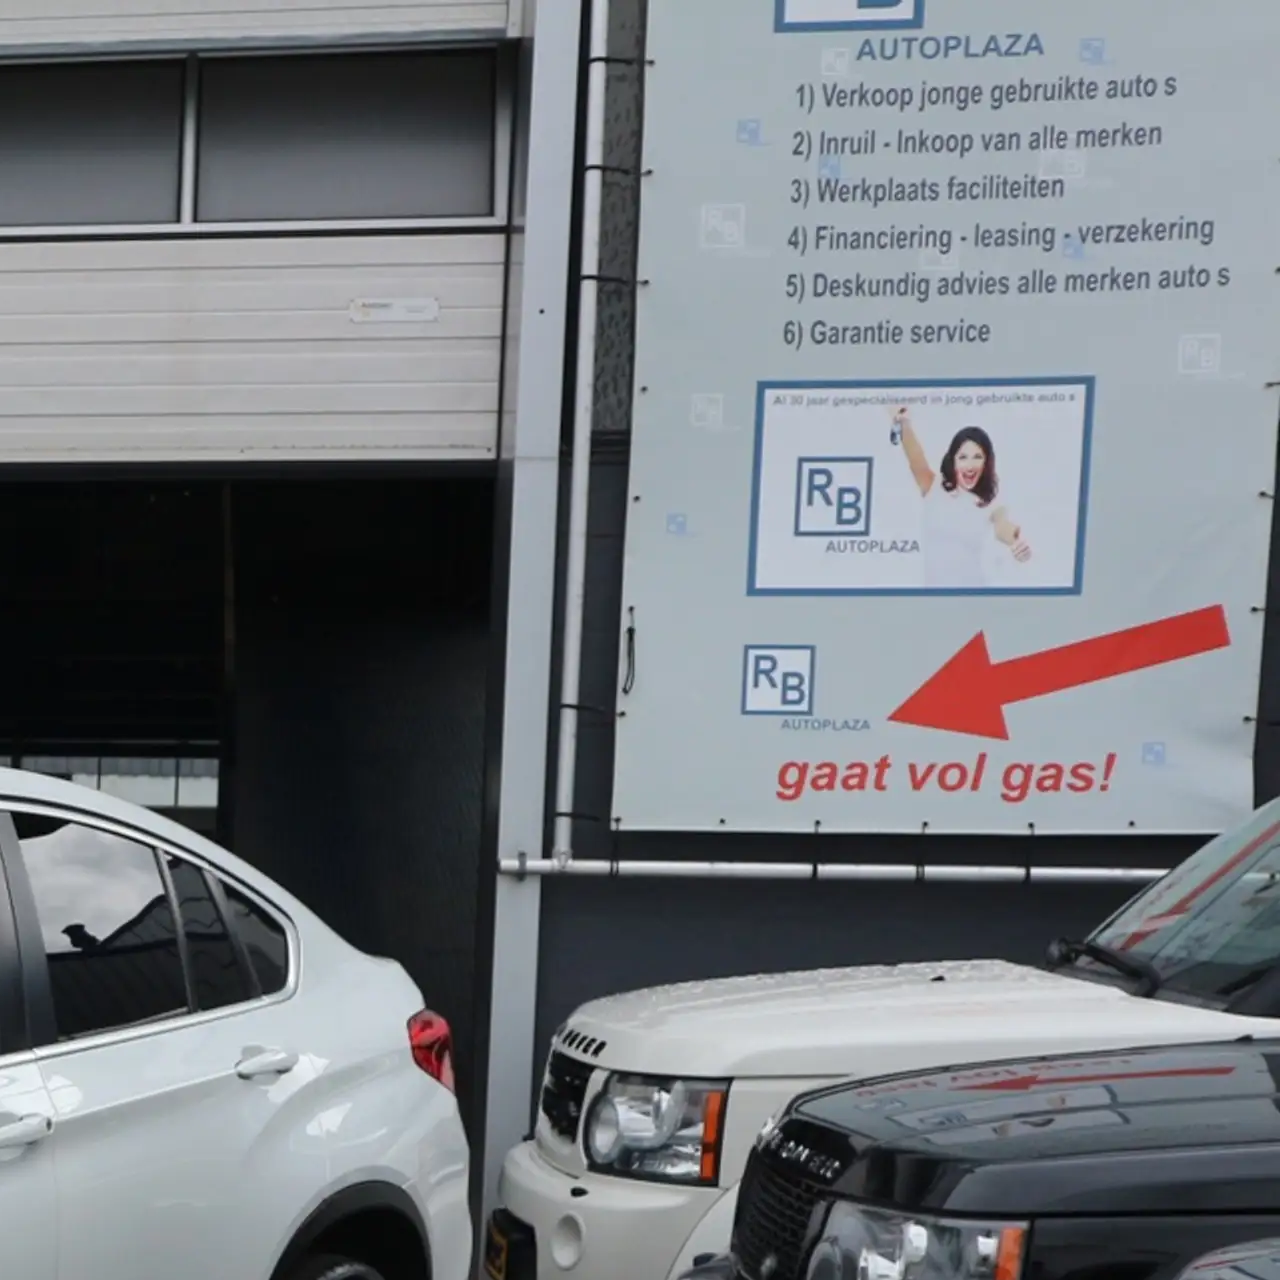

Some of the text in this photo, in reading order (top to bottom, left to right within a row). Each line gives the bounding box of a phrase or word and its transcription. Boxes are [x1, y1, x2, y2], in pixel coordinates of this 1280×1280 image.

[856, 33, 1045, 61] AUTOPLAZA
[796, 74, 1177, 115] 1) Verkoop jonge gebruikte auto s
[792, 131, 813, 161] 2)
[819, 129, 876, 155] Inruil
[897, 128, 974, 158] Inkoop
[981, 132, 1021, 152] van
[1028, 124, 1069, 151] alle
[1075, 121, 1163, 148] merken
[790, 173, 1065, 209] 3) Werkplaats faciliteiten
[787, 226, 808, 256] 4)
[814, 224, 952, 255] Financiering
[974, 222, 1057, 252] leasing
[1078, 215, 1215, 246] verzekering
[785, 264, 1231, 304] 5) Deskundig advies alle merken auto s
[783, 318, 991, 351] 6) Garantie service
[945, 393, 974, 406] jong
[807, 467, 863, 526] RB
[825, 539, 921, 554] AUTOPLAZA
[752, 655, 807, 706] RB
[781, 717, 872, 732] AUTOPLAZA
[776, 752, 1118, 804] gaat vol gas!
